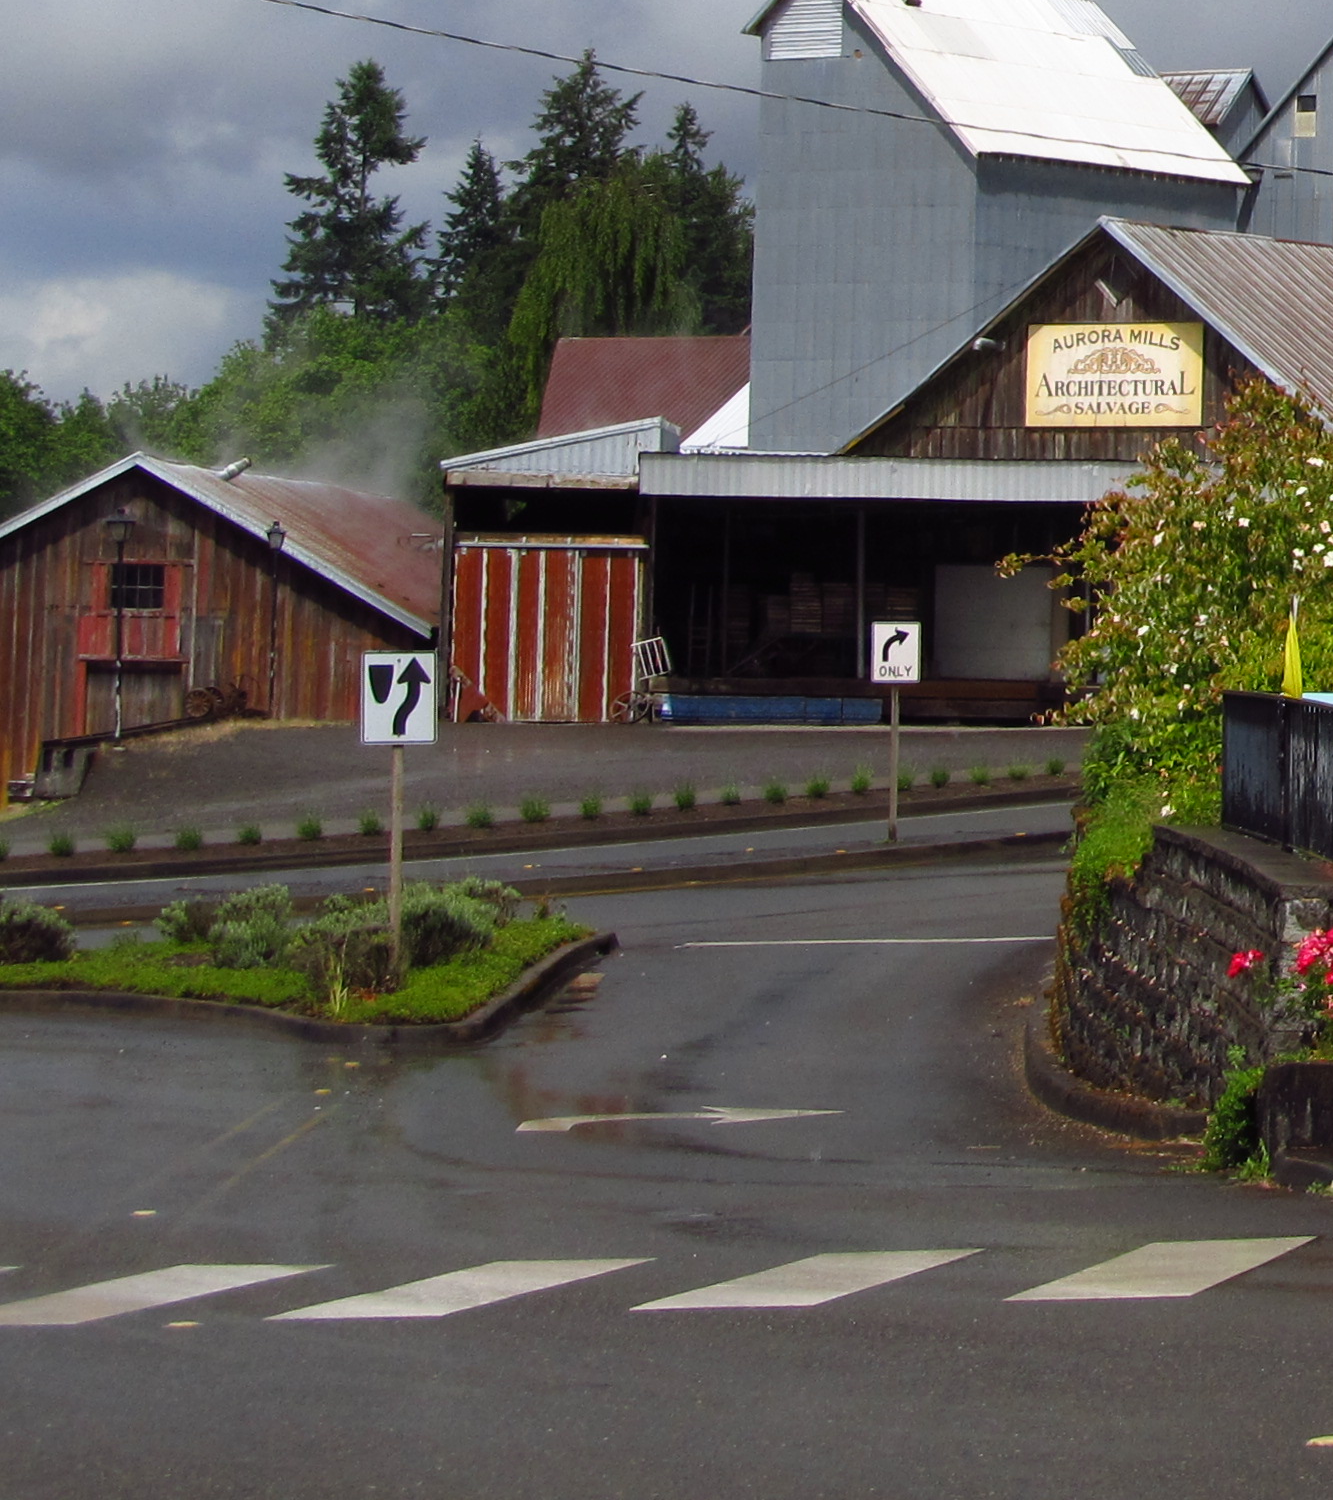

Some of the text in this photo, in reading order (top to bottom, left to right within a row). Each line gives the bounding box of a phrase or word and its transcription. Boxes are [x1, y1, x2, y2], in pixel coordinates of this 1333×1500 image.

[1053, 328, 1182, 353] AURORA MILLS
[1035, 371, 1196, 398] ARCHITECTURAL
[1073, 400, 1151, 415] SALVAGE
[879, 665, 912, 677] ONLY
